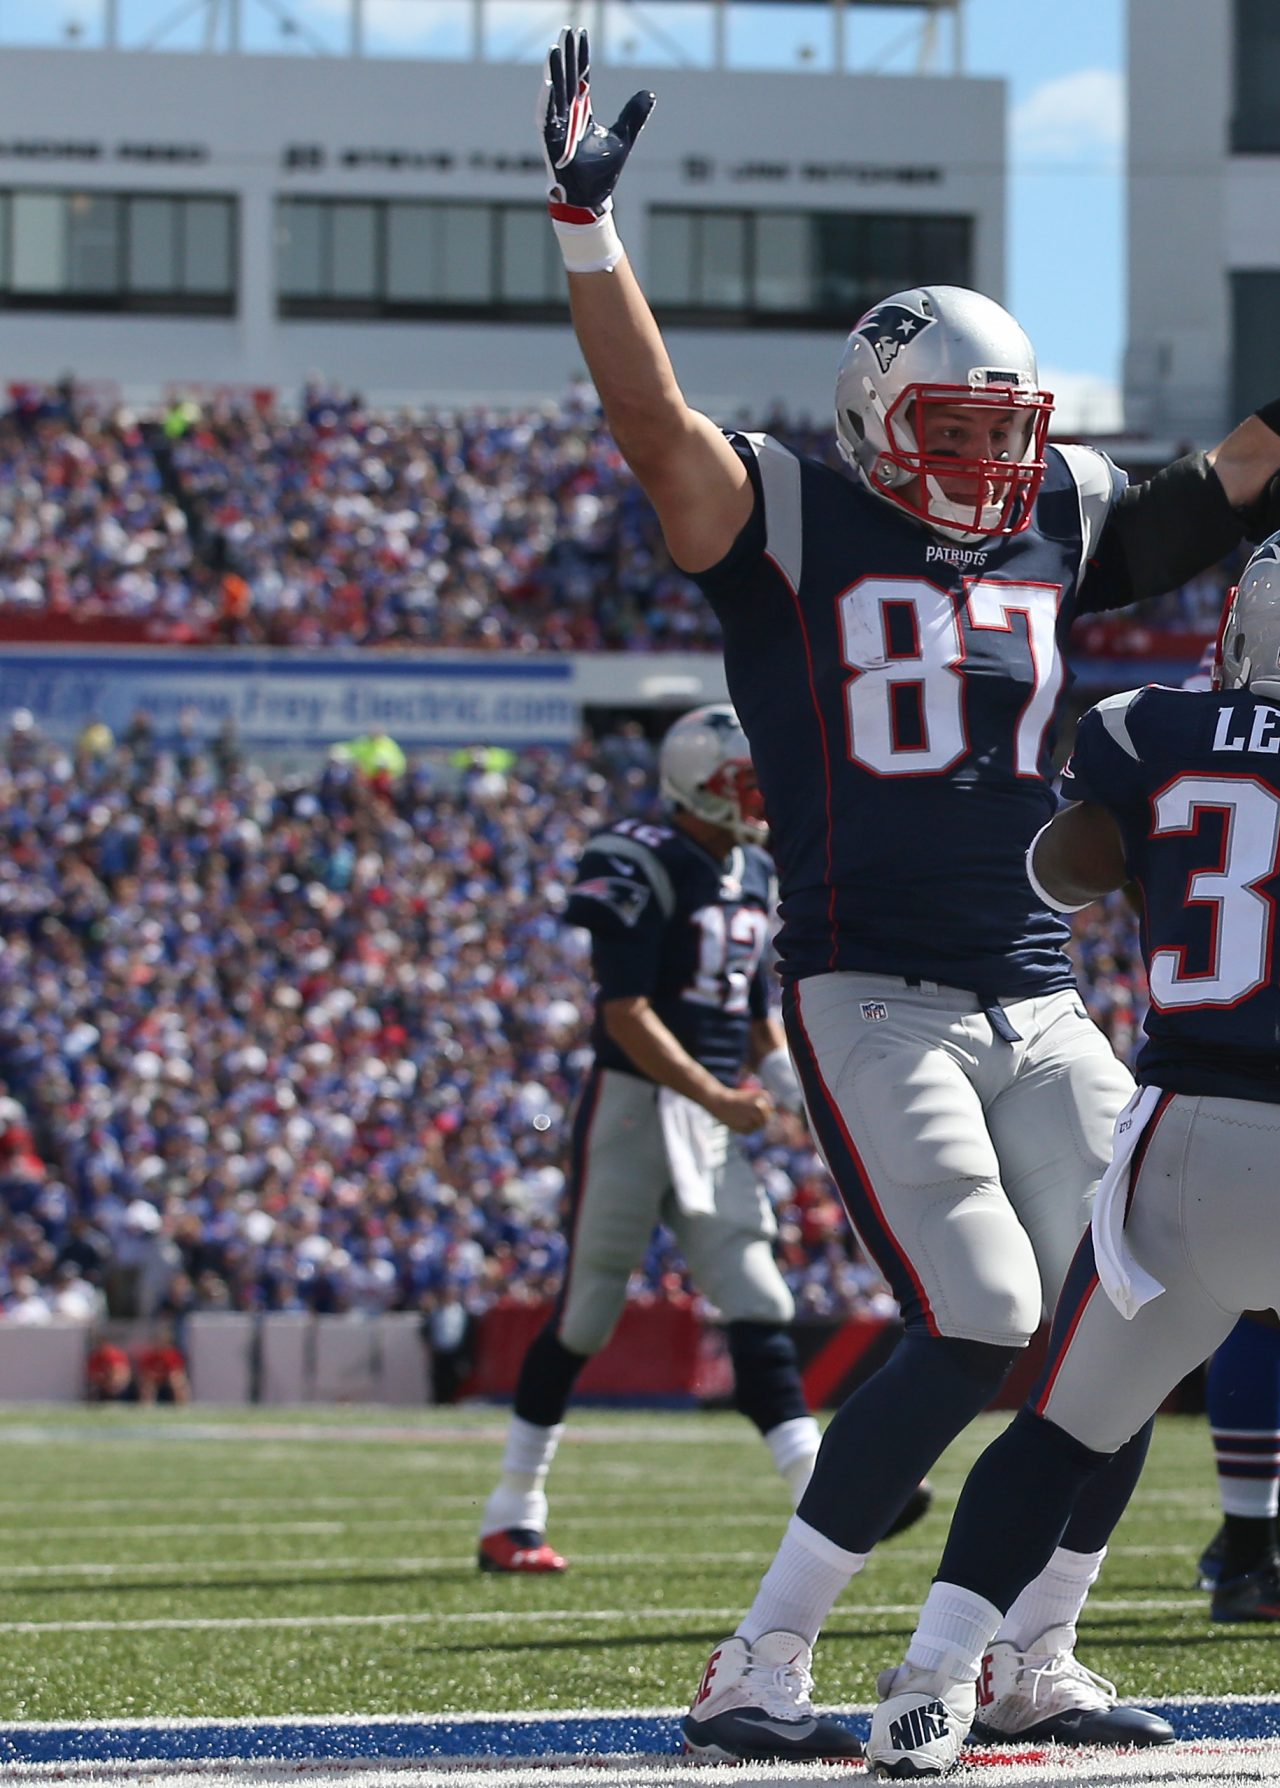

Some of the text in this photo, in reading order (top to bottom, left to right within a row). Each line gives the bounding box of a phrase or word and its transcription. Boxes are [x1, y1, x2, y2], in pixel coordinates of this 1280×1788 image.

[926, 546, 988, 567] PATRIOTS
[834, 573, 1065, 780] 87
[680, 905, 769, 1014] 12
[889, 1701, 950, 1750] NIKE
